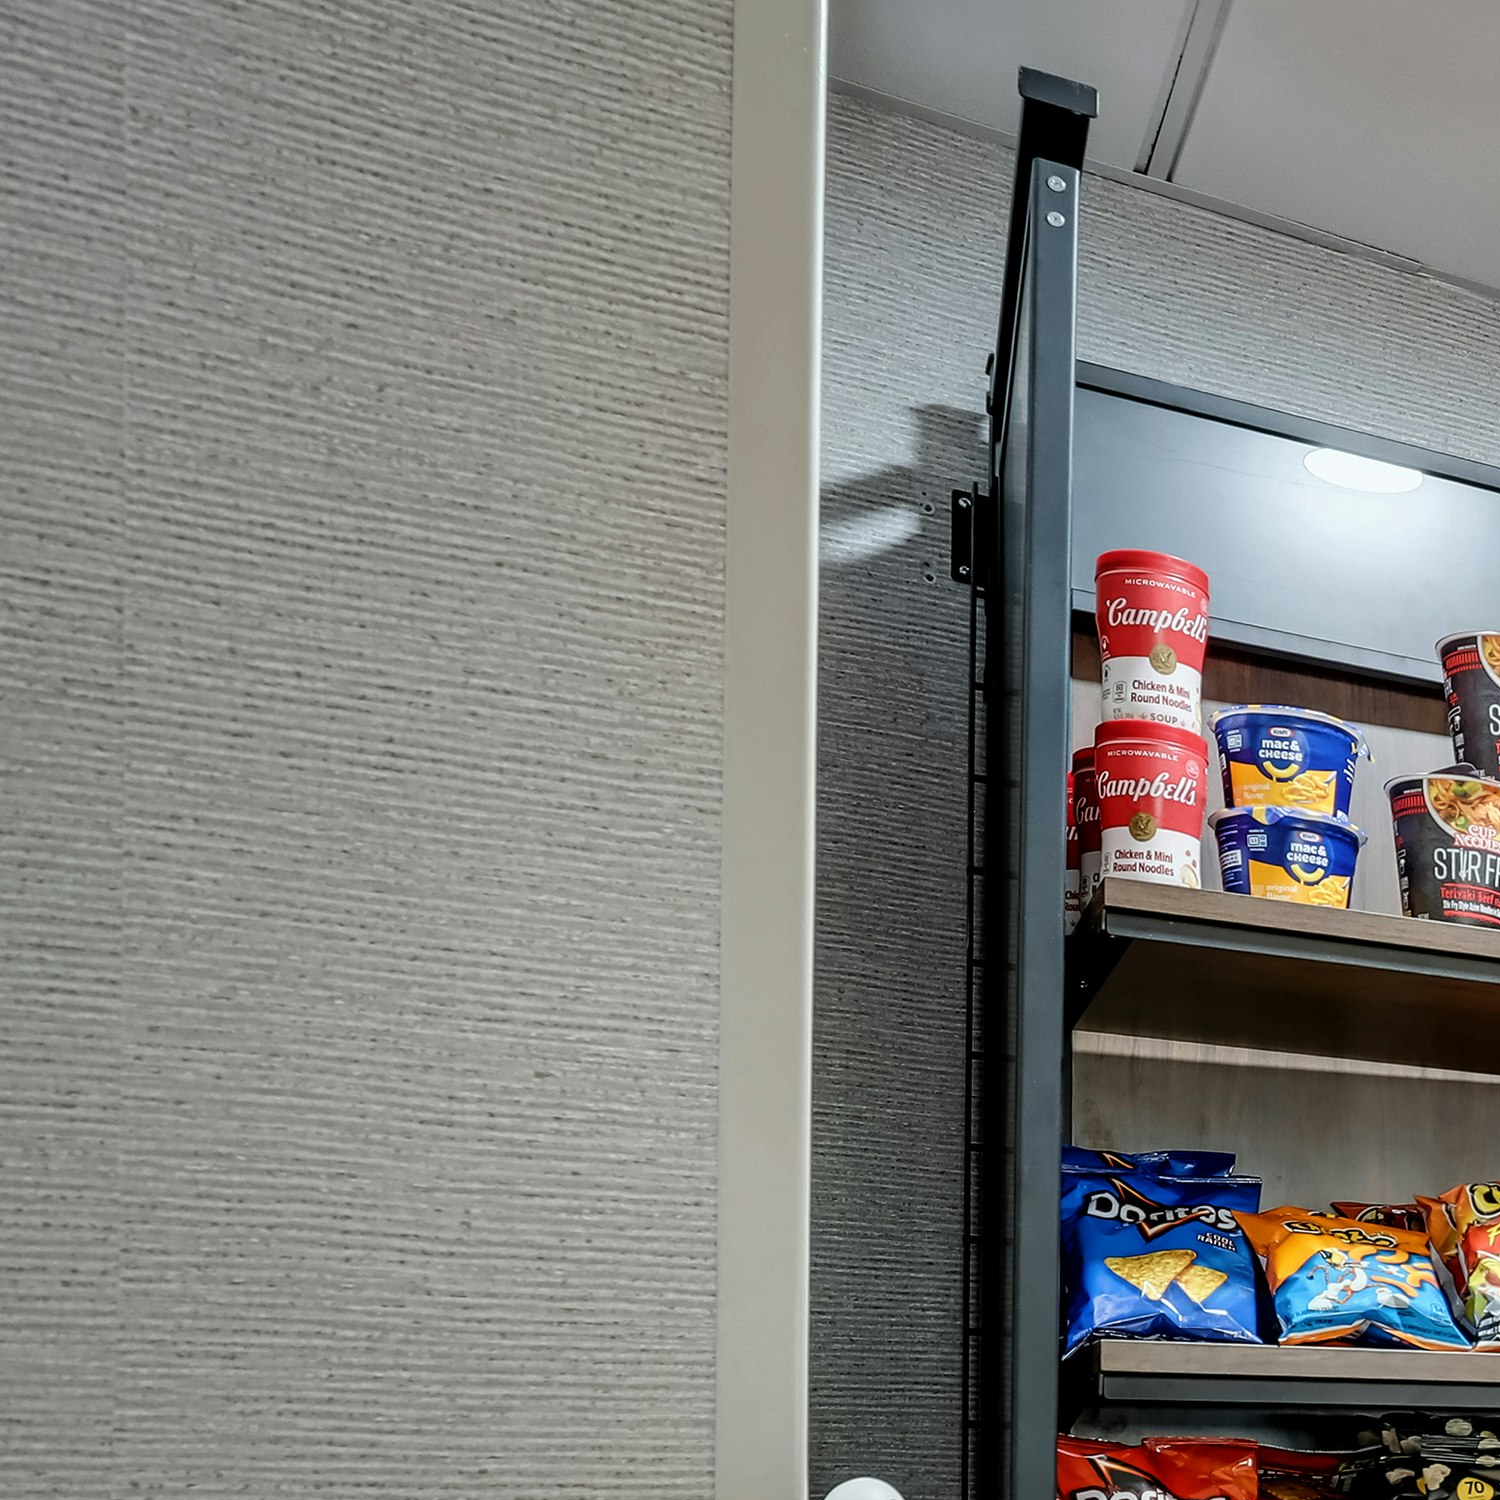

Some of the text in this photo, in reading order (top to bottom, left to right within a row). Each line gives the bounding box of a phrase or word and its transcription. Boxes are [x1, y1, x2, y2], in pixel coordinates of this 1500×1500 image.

[1124, 578, 1196, 599] MICROWAVABLE
[1106, 597, 1208, 644] Campbell's
[1132, 679, 1175, 694] Chicken &
[1130, 692, 1192, 713] Round Noodles
[1150, 712, 1178, 725] SOUP
[1107, 750, 1179, 762] MICROWAVABLE
[1096, 770, 1197, 806] Campbell's
[1467, 824, 1497, 838] CUP
[1114, 849, 1174, 863] Chicken & Mini
[1112, 862, 1175, 877] Round Noodles
[1440, 886, 1476, 900] Teriyaki
[1087, 1192, 1238, 1230] Doritos
[1197, 1234, 1237, 1252] RANCH
[1206, 1232, 1234, 1247] COOL
[1463, 1479, 1485, 1495] 70
